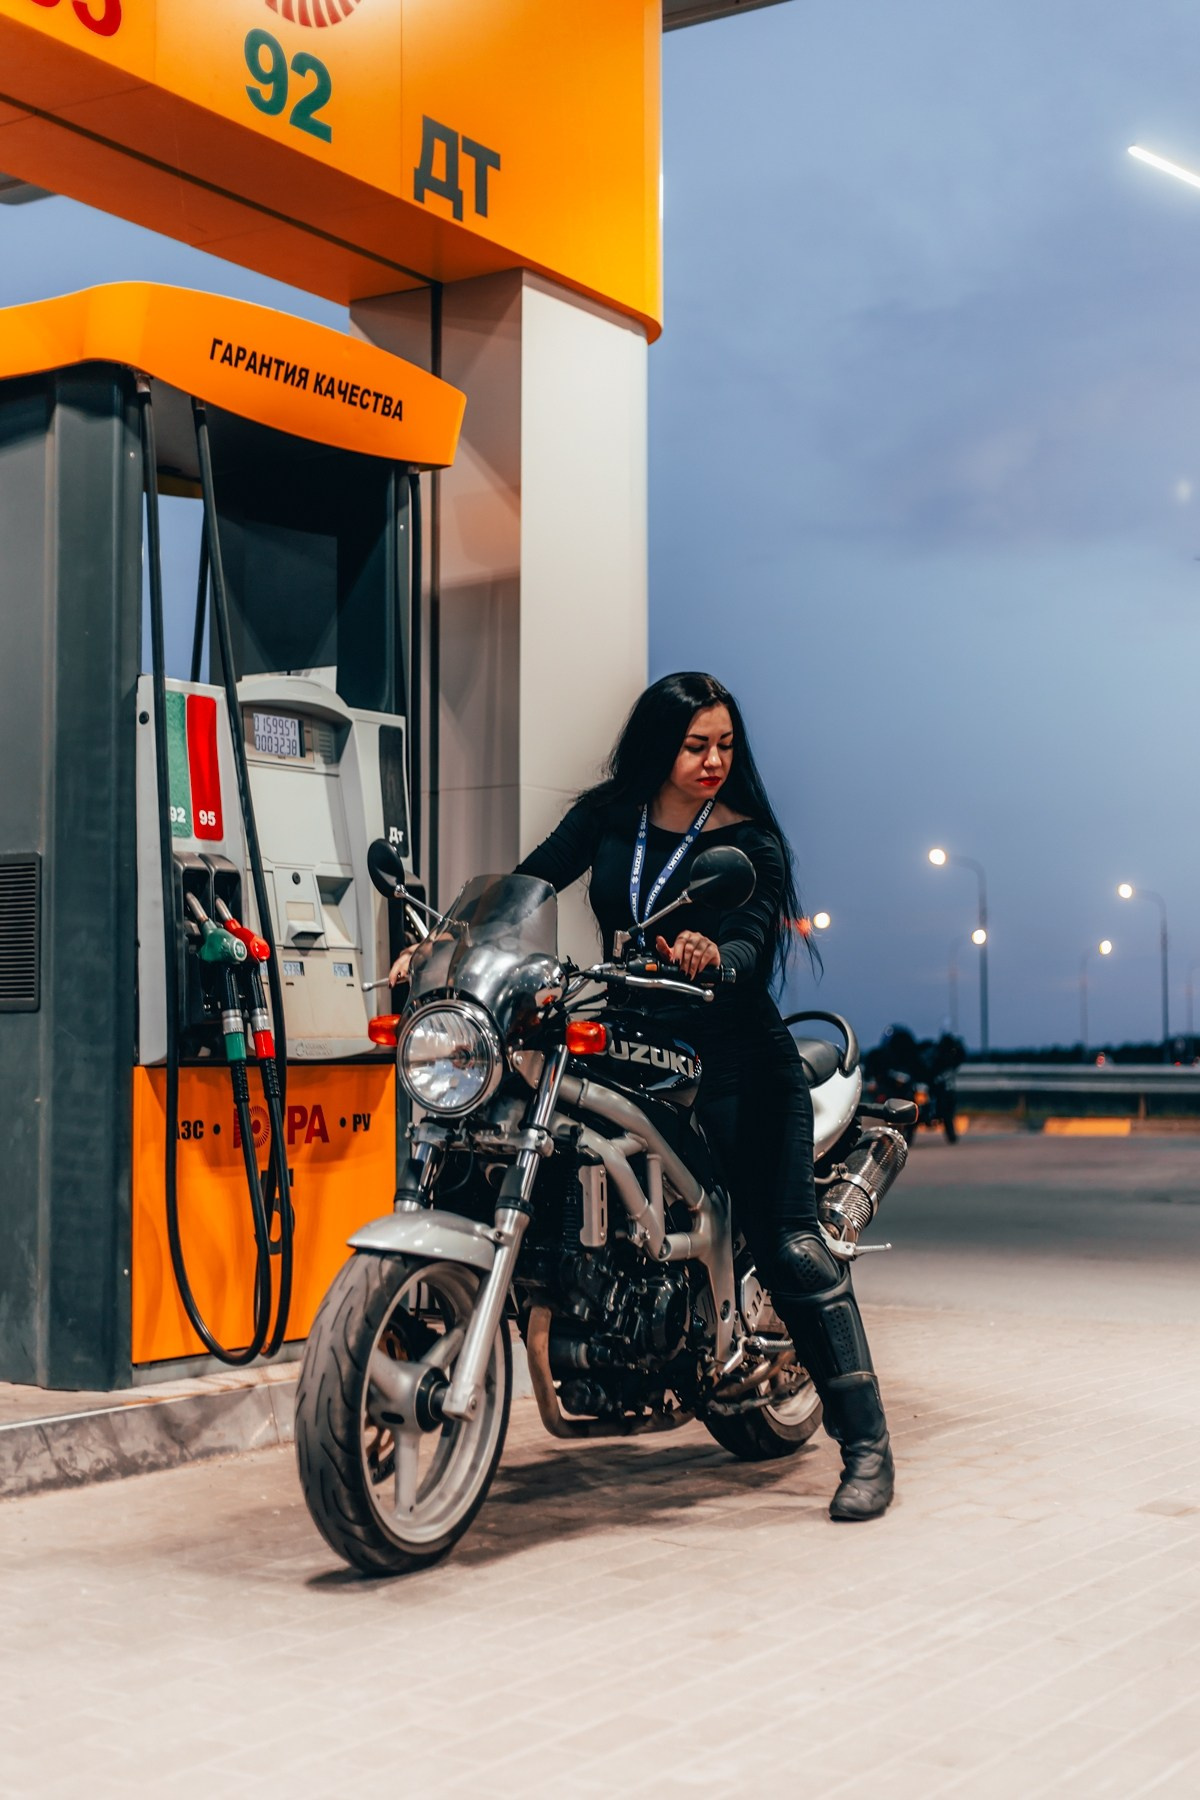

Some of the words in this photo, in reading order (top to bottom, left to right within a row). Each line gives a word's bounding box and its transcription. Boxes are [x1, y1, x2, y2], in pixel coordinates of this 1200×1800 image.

[244, 28, 332, 144] 92
[413, 114, 501, 222] ДТ
[209, 338, 310, 391] ГАРАНТИЯ
[312, 372, 404, 422] КАЧЕСТВА
[169, 806, 186, 824] 92
[198, 810, 216, 827] 95
[694, 800, 714, 831] SUZUKI
[632, 845, 643, 876] SUZUKI
[667, 842, 689, 871] SUZUKI
[594, 1040, 695, 1079] UZUKI
[176, 1119, 204, 1140] ЗС
[352, 1113, 371, 1132] РУ
